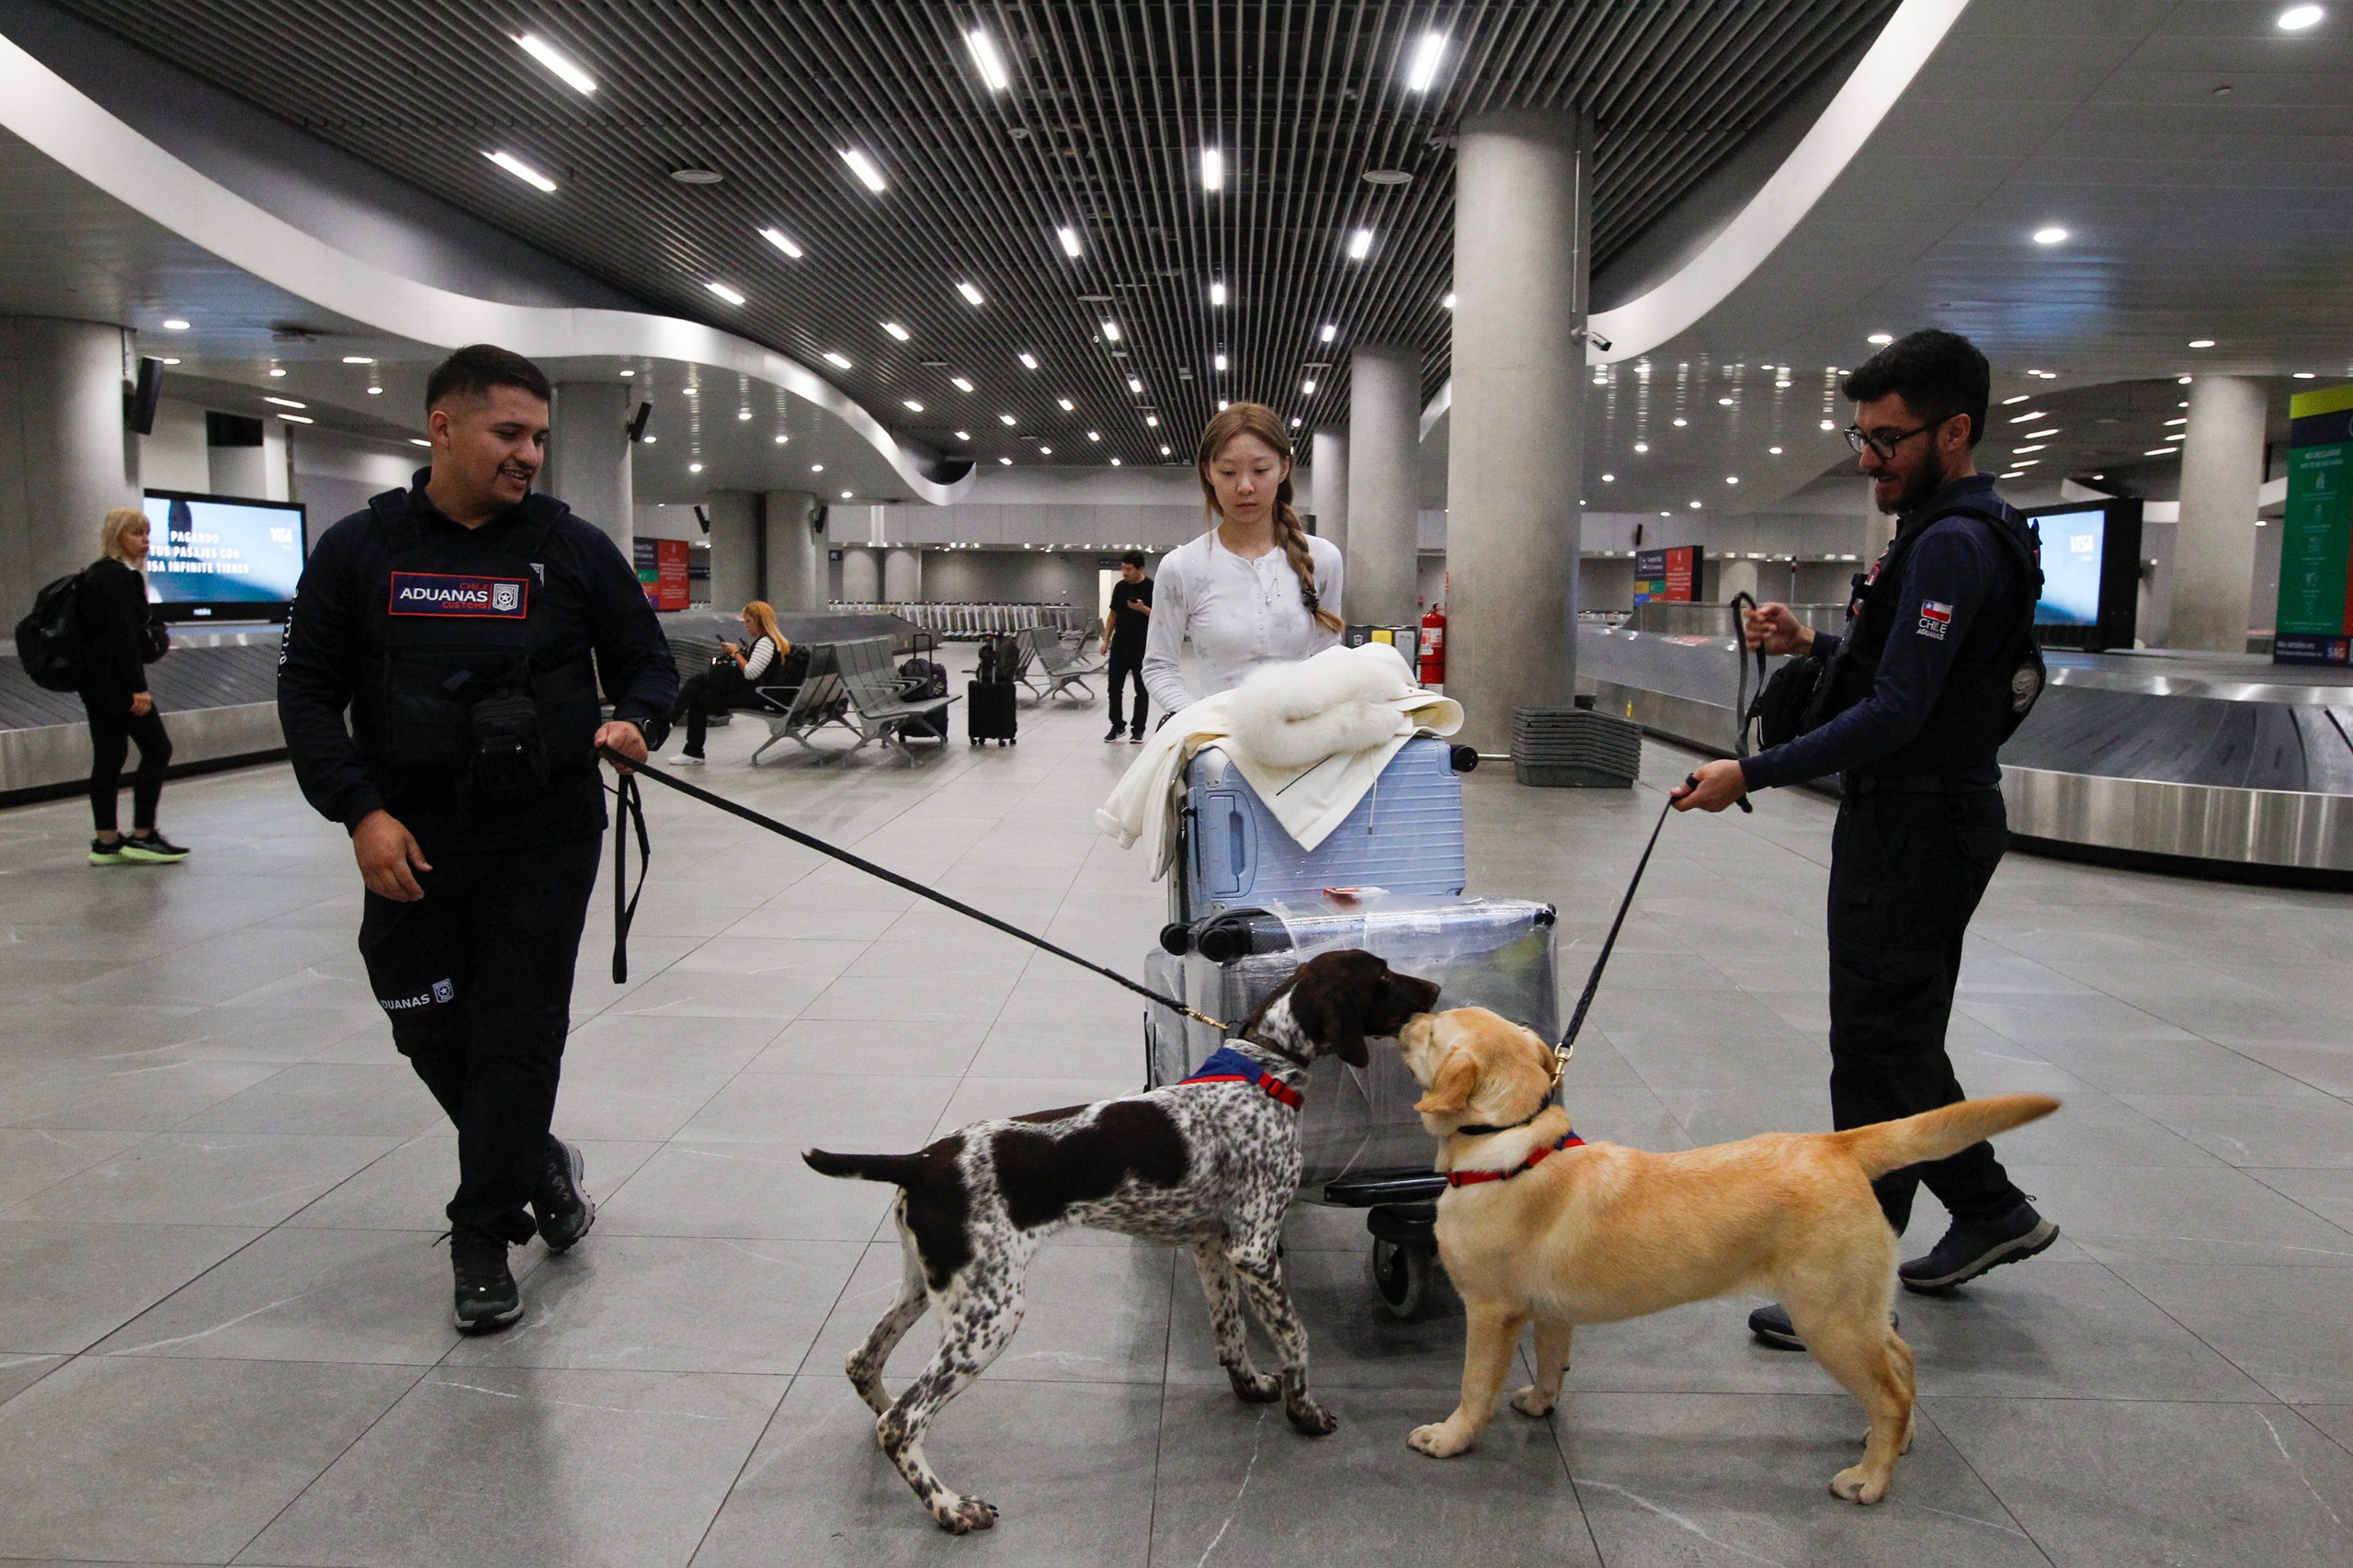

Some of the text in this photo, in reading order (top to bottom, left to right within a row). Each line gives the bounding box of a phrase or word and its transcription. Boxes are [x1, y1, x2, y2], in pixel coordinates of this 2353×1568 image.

[170, 530, 220, 544] PAGANDO
[270, 528, 293, 543] VISA
[2069, 535, 2094, 553] VISA
[150, 545, 240, 560] TUS PASAJES CON
[147, 561, 249, 574] ISA INFINITE TIENES
[400, 588, 488, 602] ADUANAS
[1918, 619, 1948, 633] CHILE
[1916, 629, 1944, 641] ADUANAS
[381, 994, 431, 1009] DUANAS
